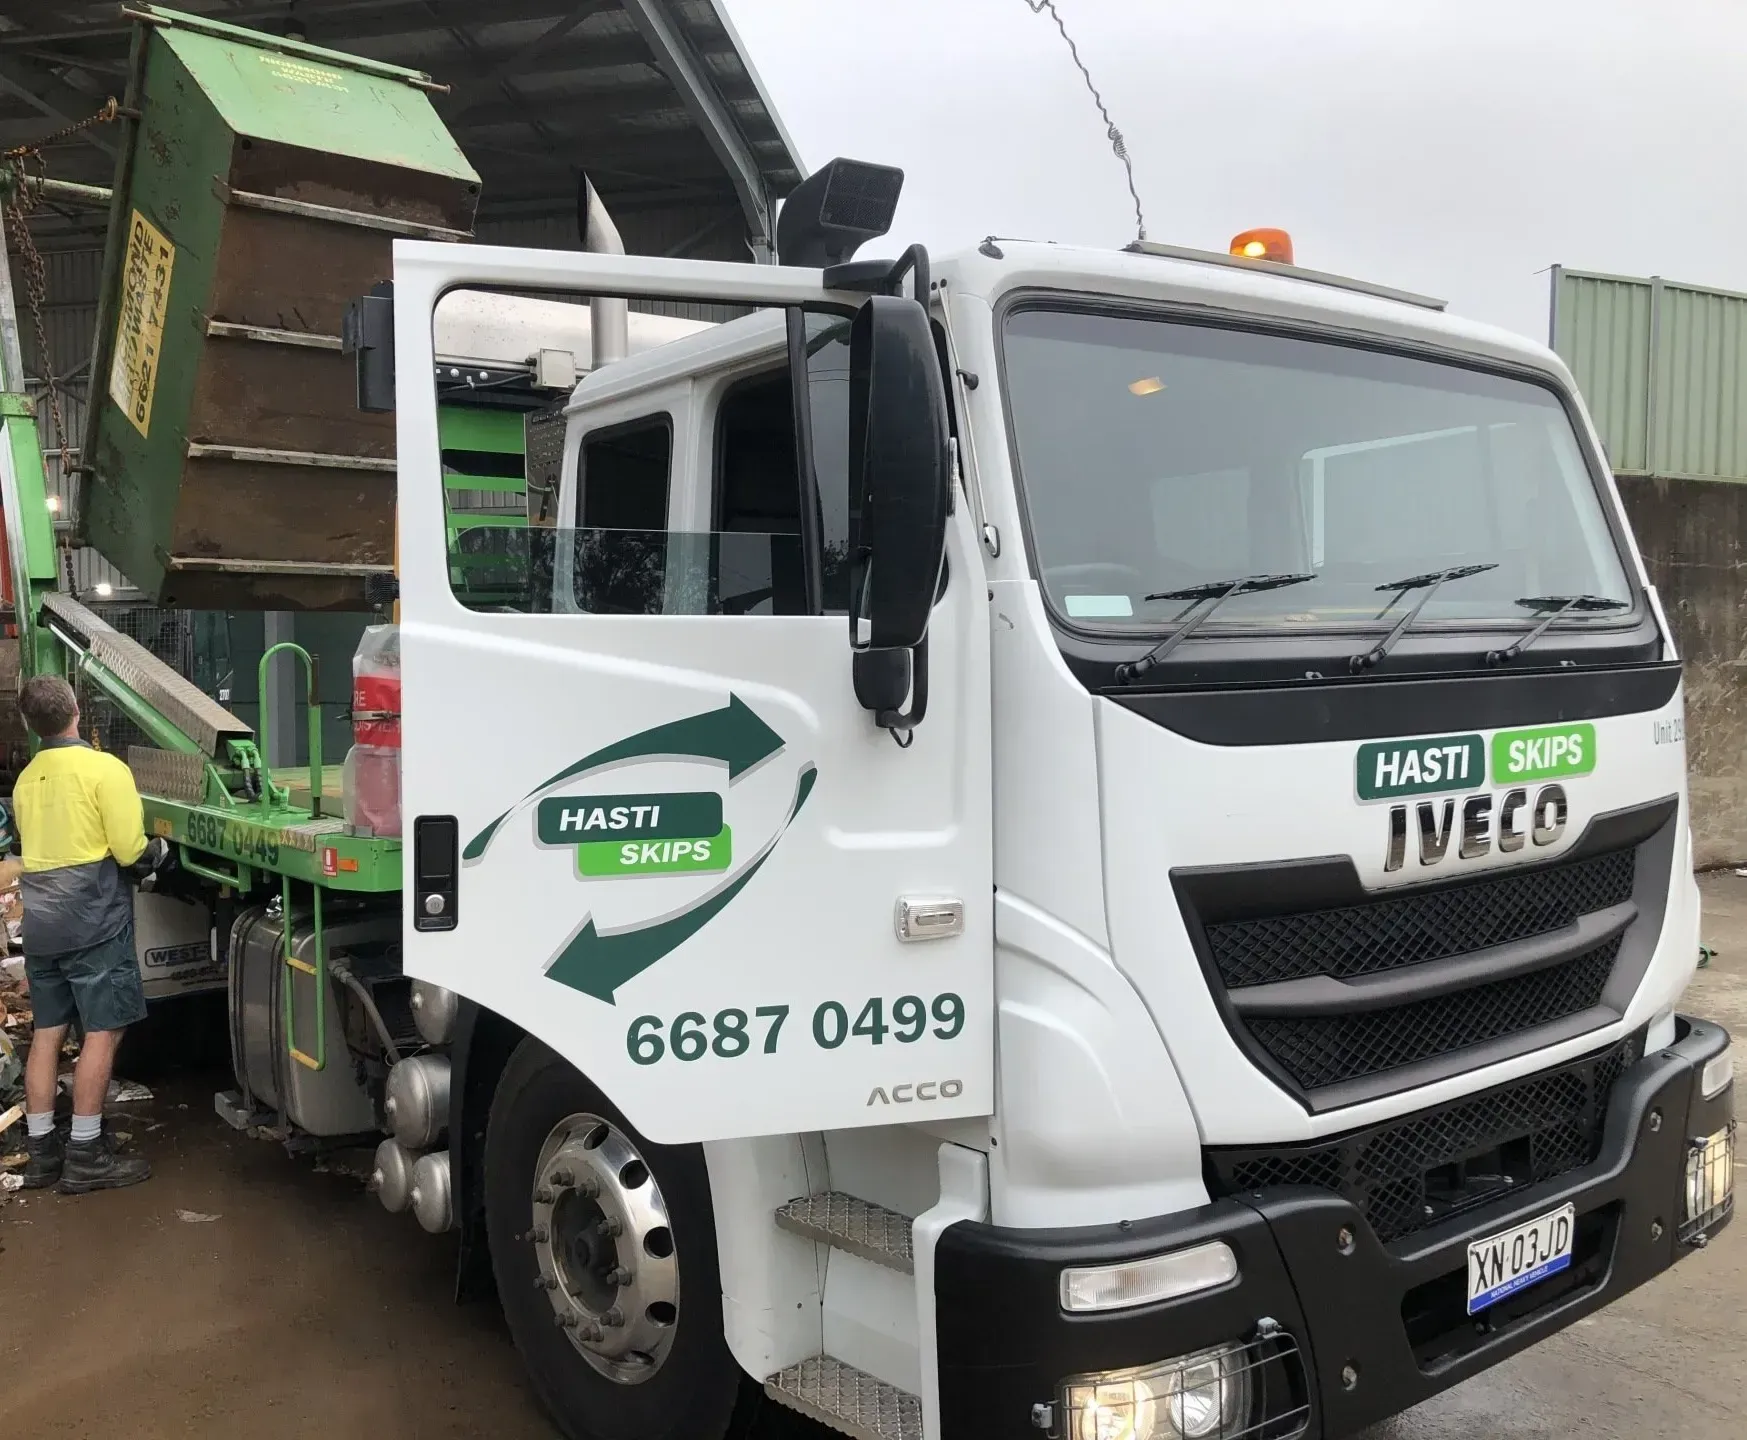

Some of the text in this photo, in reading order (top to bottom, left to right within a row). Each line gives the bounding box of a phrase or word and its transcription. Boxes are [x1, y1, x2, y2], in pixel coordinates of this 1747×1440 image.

[136, 244, 169, 423] 6621 7431
[1653, 719, 1672, 745] Unit
[1375, 733, 1583, 789] HASTI SKIPS
[187, 811, 279, 866] 6687 0449
[559, 805, 660, 832] HASTI
[1384, 784, 1569, 873] IVECO
[619, 840, 711, 866] SKIPS
[626, 992, 966, 1066] 6687 0499
[866, 1080, 964, 1108] ACCO
